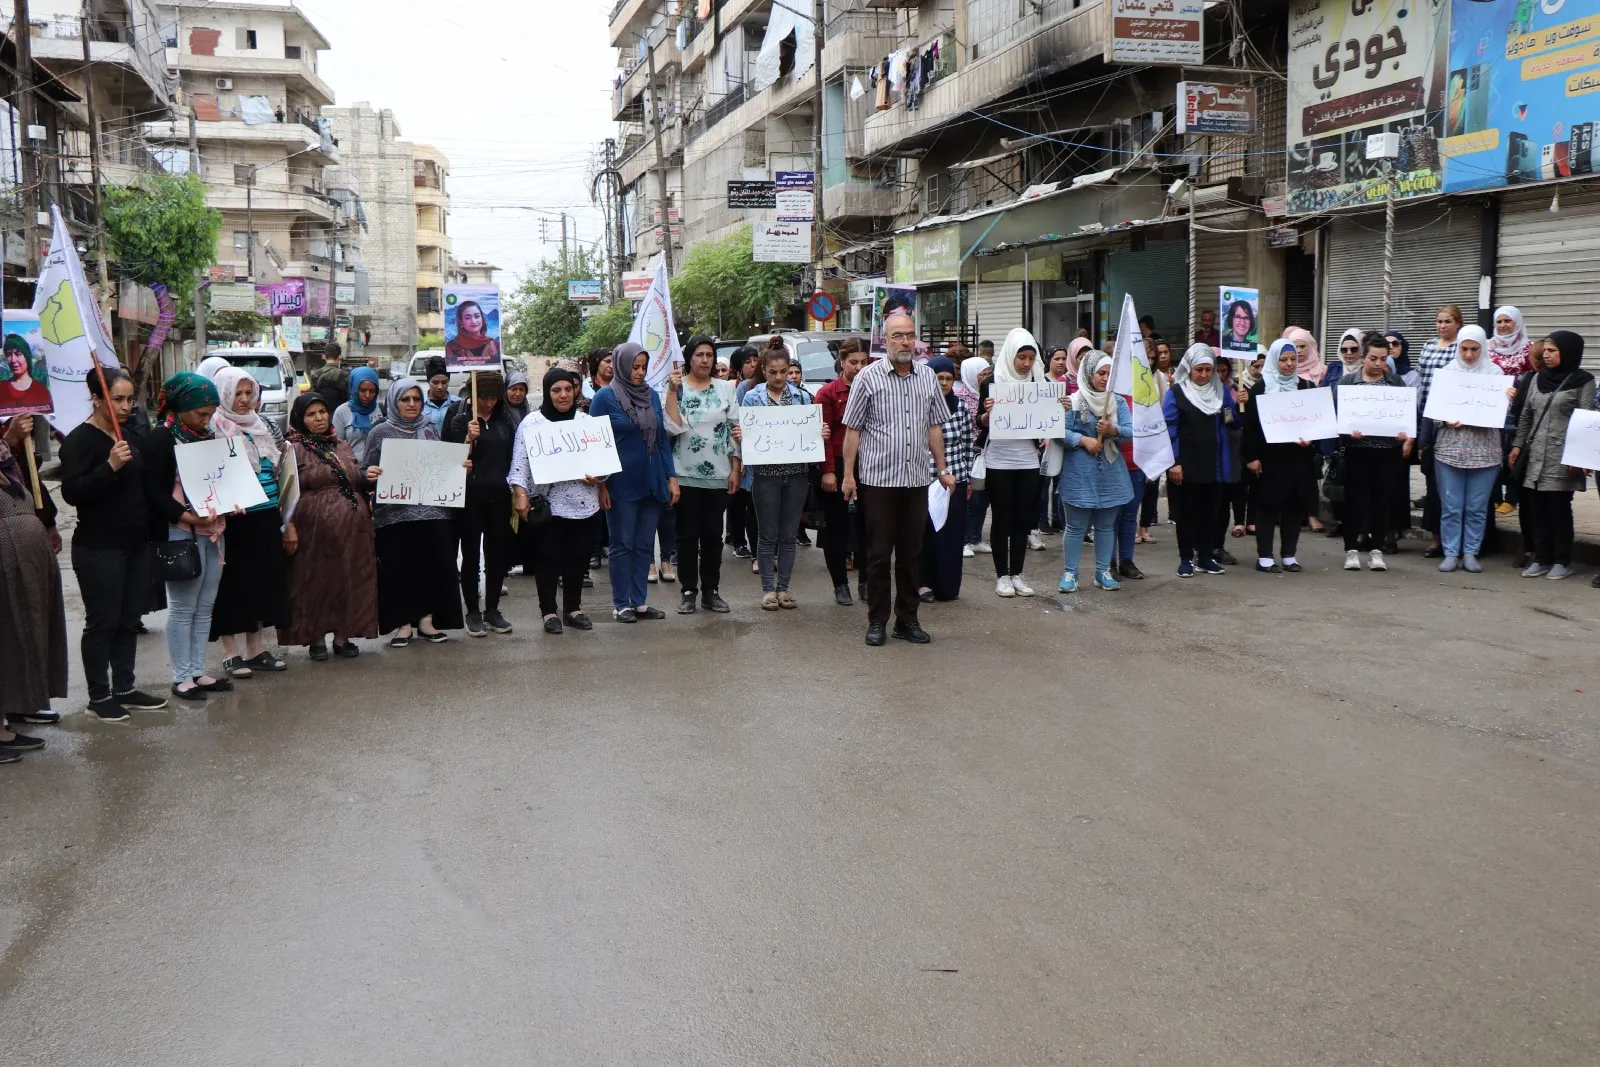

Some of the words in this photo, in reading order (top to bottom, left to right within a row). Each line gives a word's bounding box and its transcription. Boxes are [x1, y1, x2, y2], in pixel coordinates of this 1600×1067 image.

[1179, 5, 1202, 14] الدكتور
[1312, 25, 1407, 101] جودي
[1570, 127, 1580, 168] Galaxy
[1581, 125, 1592, 150] S21
[1018, 384, 1025, 404] لا
[743, 410, 756, 430] في
[995, 413, 1033, 431] السلام
[1036, 411, 1060, 431] نريد
[226, 437, 237, 457] لا
[600, 426, 613, 448] لا
[787, 433, 817, 452] دمار
[203, 460, 225, 483] نريد
[378, 483, 412, 500] الأمان
[433, 486, 463, 505] نريد
